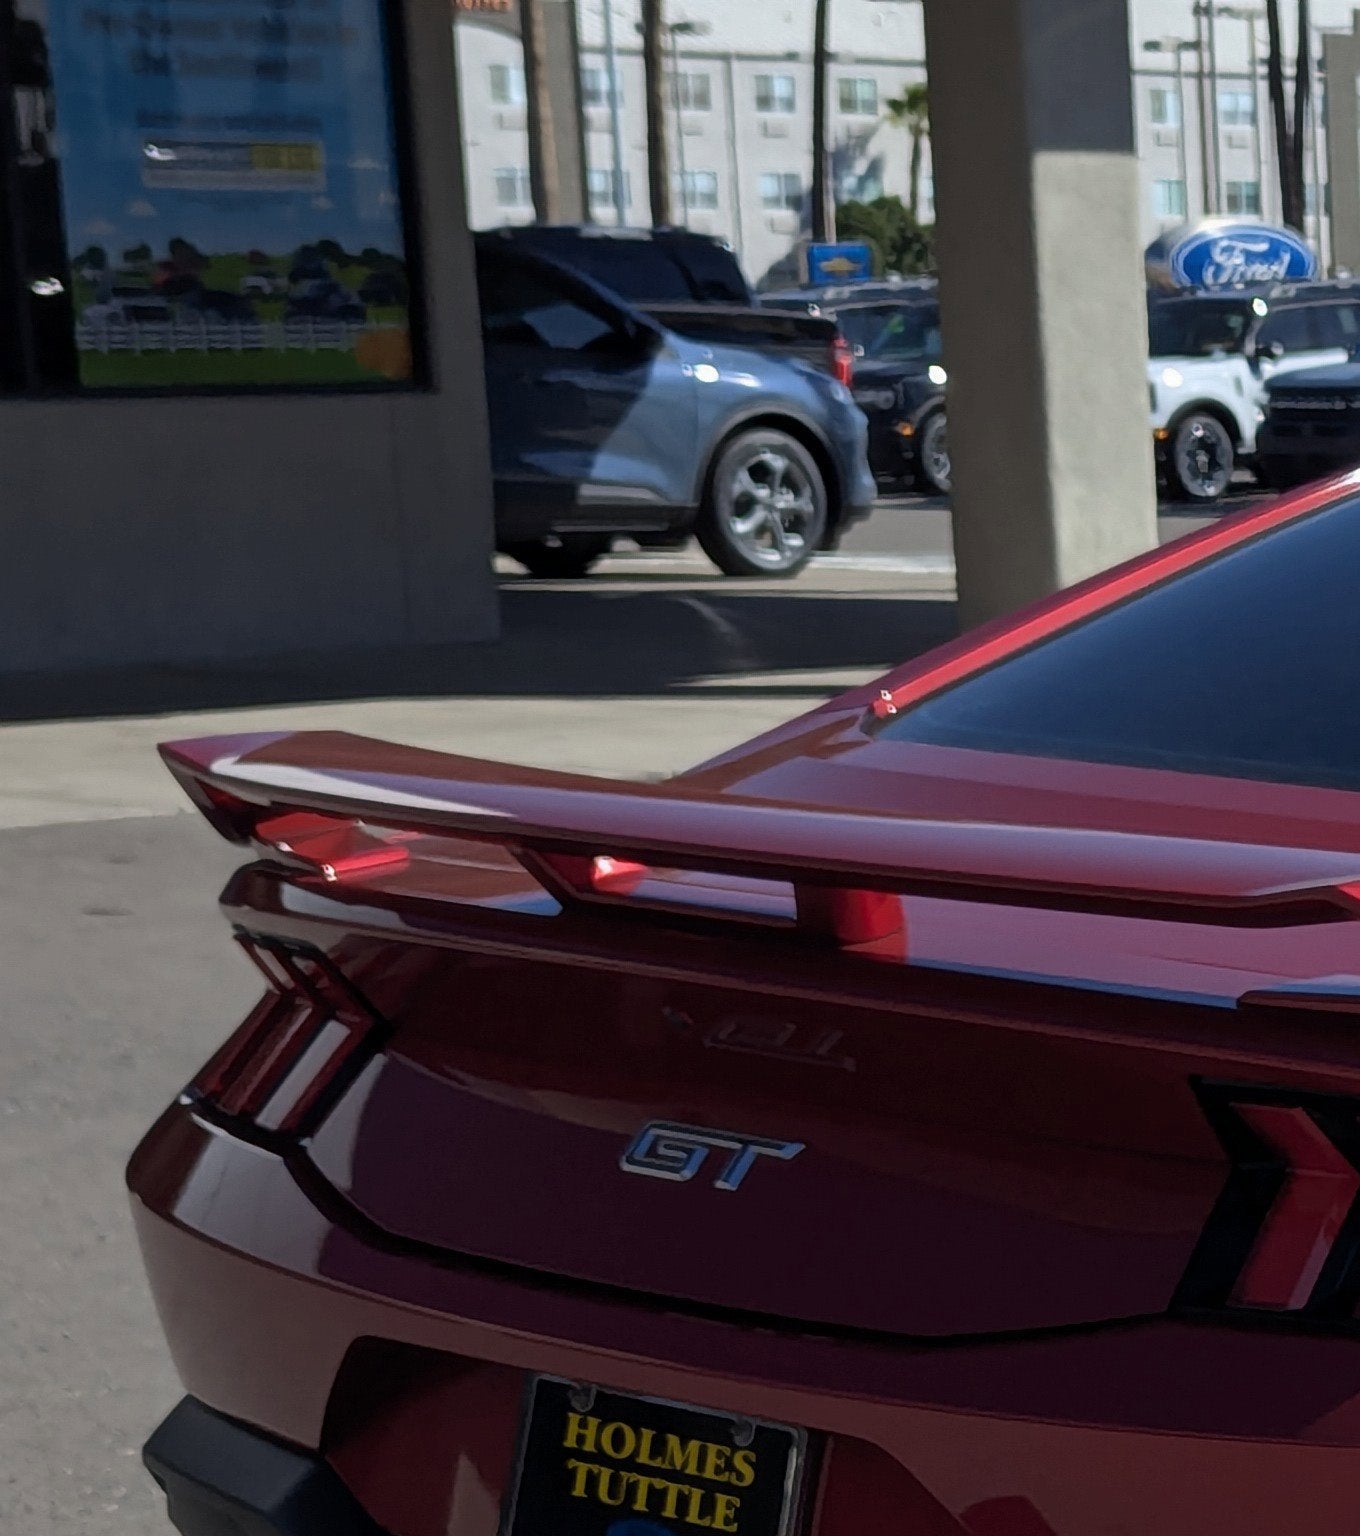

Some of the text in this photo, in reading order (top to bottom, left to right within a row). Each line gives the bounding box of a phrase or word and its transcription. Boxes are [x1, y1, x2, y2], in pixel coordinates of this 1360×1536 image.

[1202, 239, 1291, 289] Ford
[619, 1120, 806, 1191] GT
[563, 1411, 757, 1488] HOLMES
[564, 1457, 741, 1533] TUTTLE
